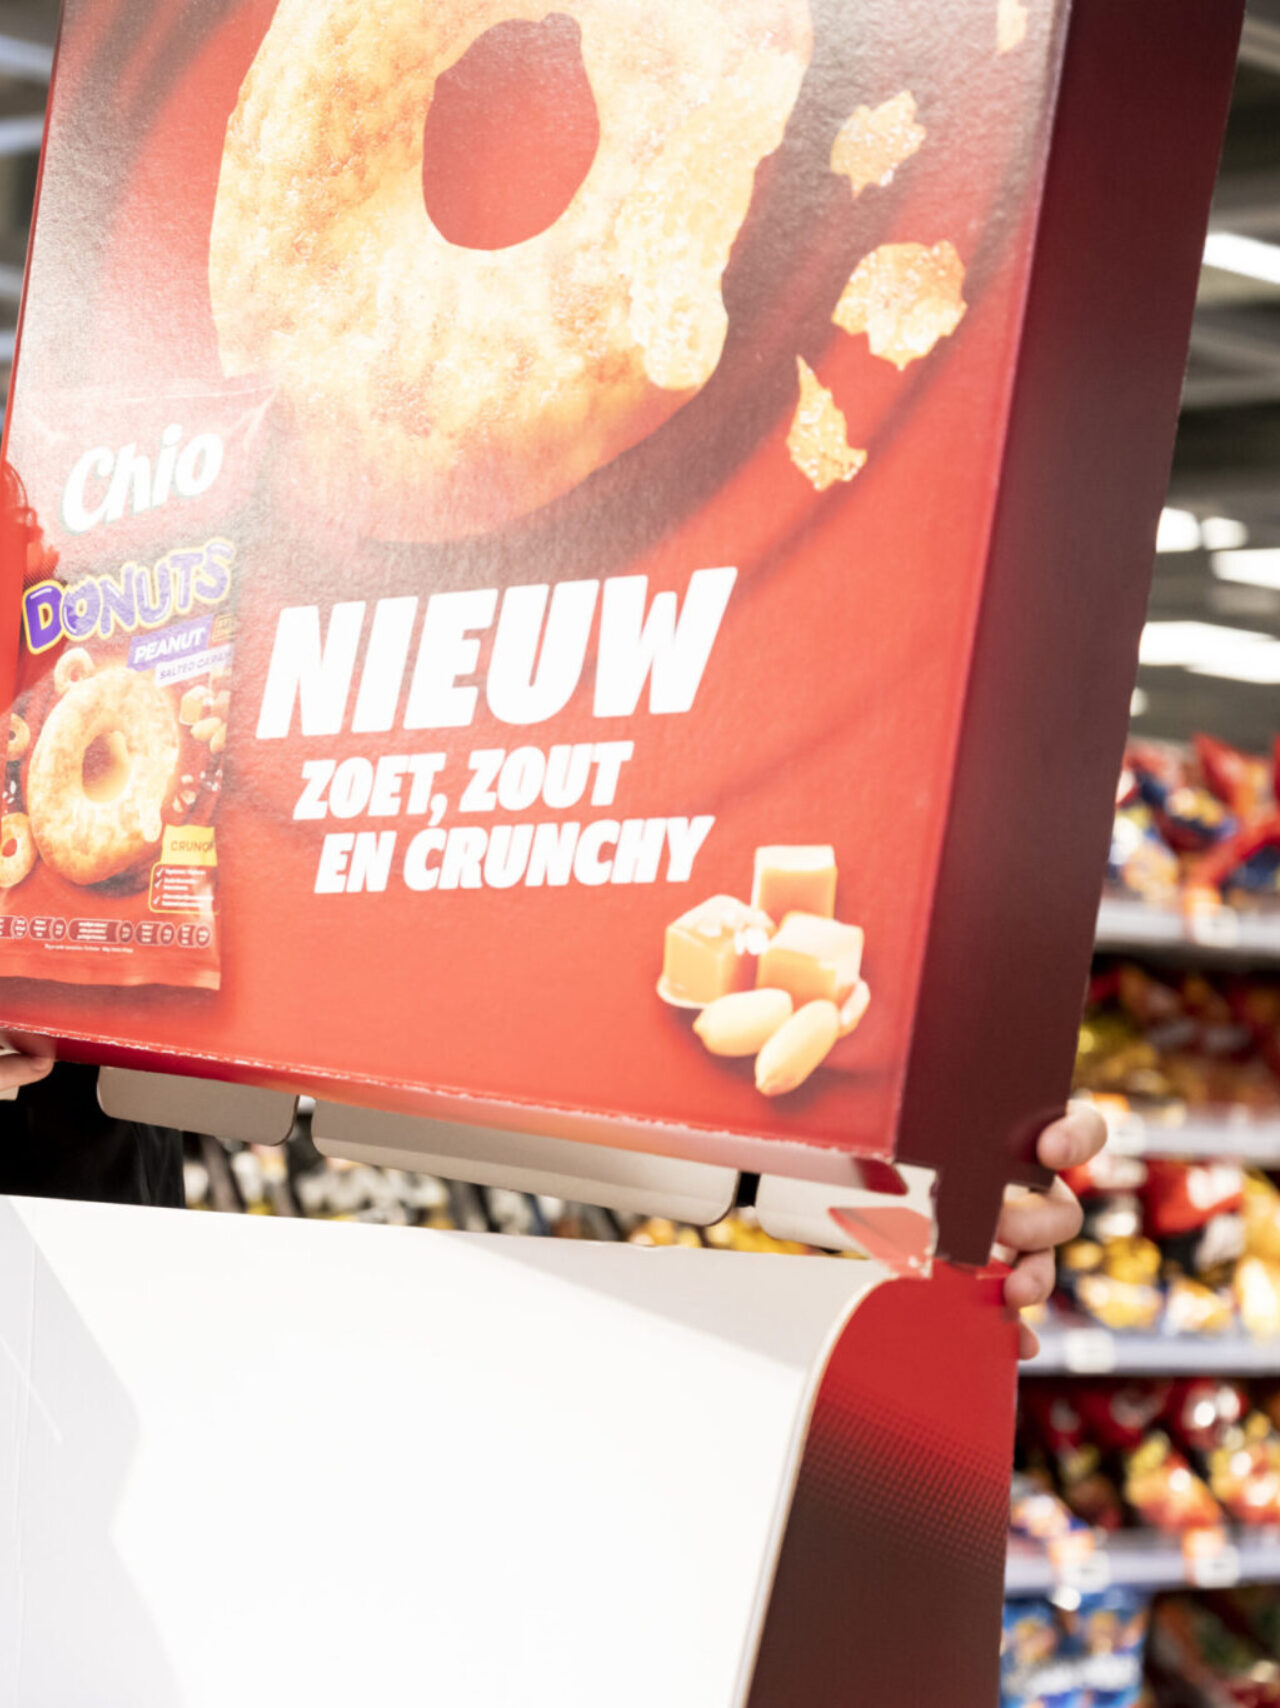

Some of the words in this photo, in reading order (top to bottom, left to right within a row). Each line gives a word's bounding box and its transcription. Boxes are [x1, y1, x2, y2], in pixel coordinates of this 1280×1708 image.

[60, 423, 224, 536] Chio
[23, 537, 235, 655] DONUTS
[133, 626, 206, 665] PEANUT
[256, 567, 738, 739] NIEUW
[292, 752, 447, 827] ZOET,
[458, 741, 635, 812] ZOUT
[314, 830, 398, 894] EN
[402, 815, 716, 892] CRUNCHY
